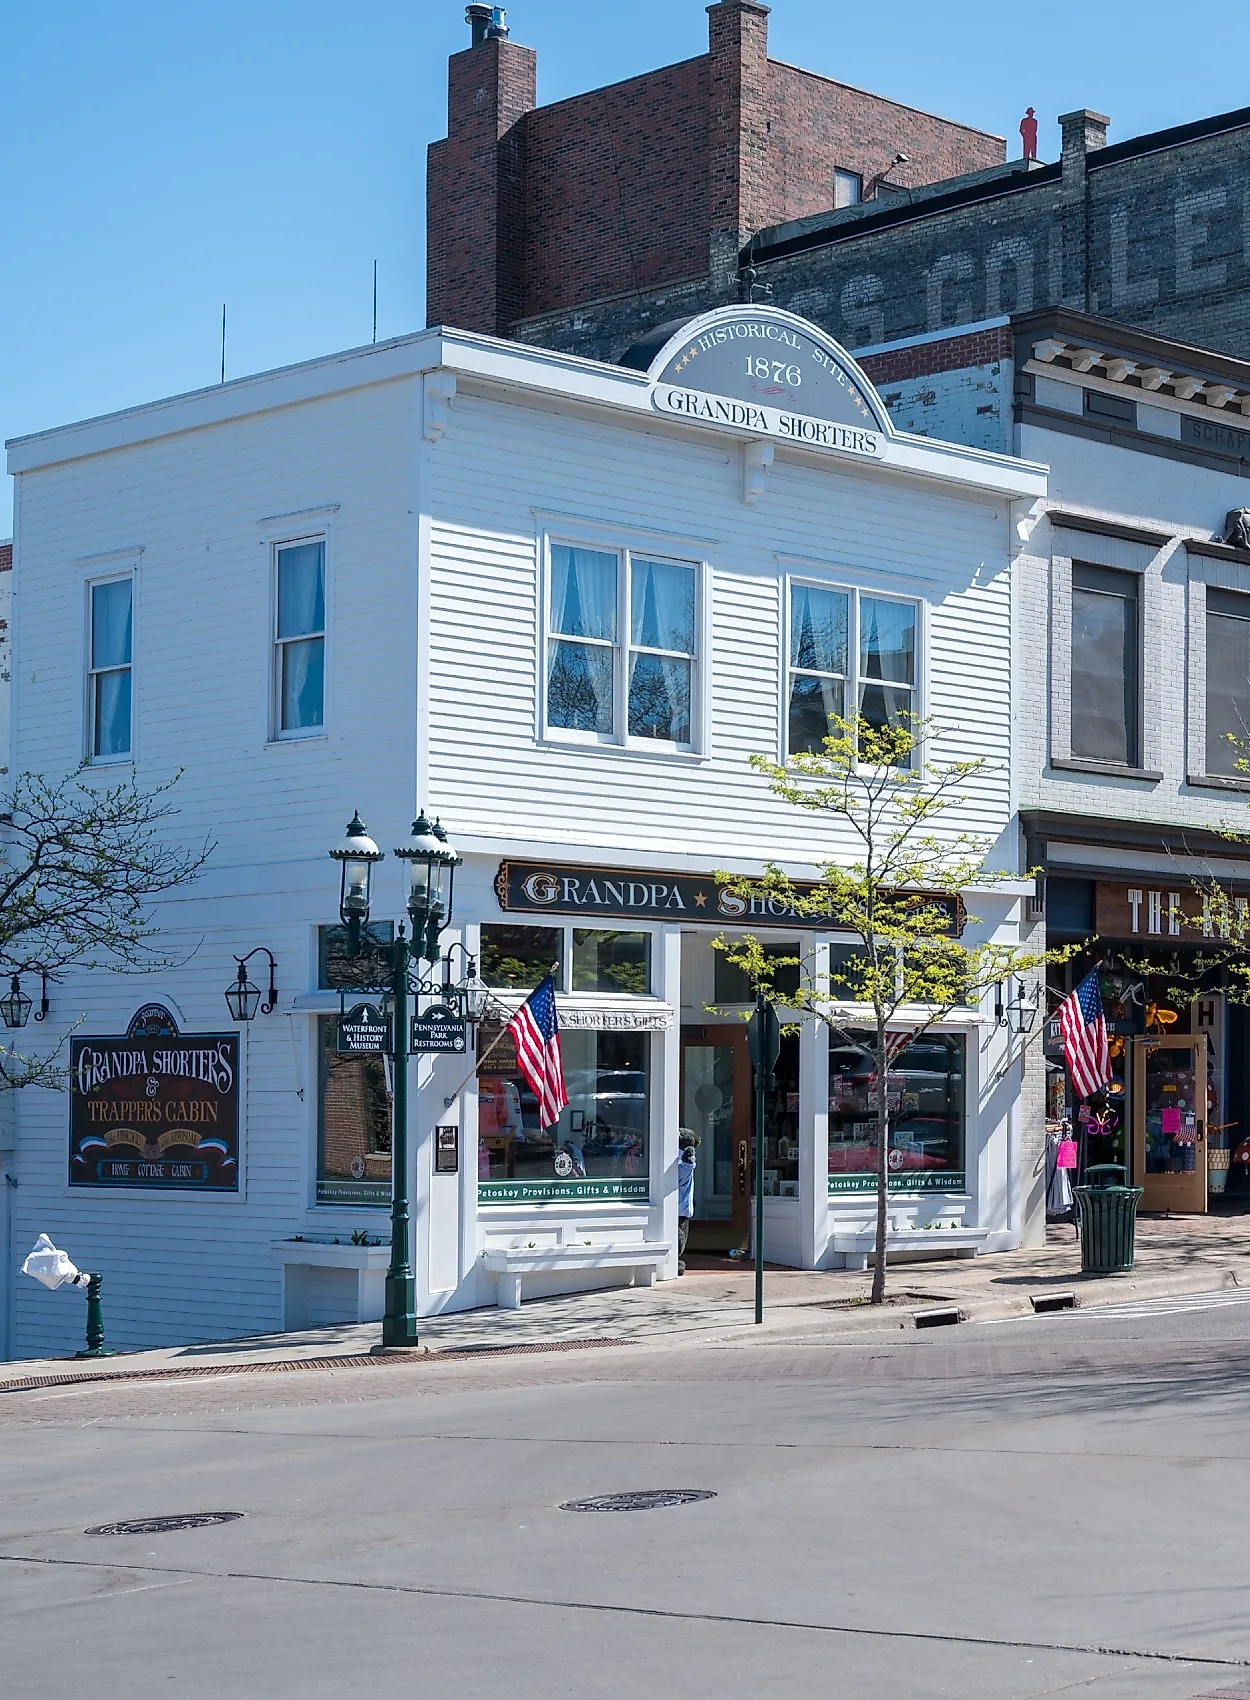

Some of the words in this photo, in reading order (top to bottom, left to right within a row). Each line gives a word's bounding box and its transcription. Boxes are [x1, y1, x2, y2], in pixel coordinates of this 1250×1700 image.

[698, 323, 801, 352] HISTORICAL
[811, 348, 849, 387] SITE
[745, 354, 802, 387] 1876
[667, 390, 769, 430] GRANDPA
[778, 415, 877, 454] SHORTER'S
[521, 872, 687, 910] GRANDPA
[1127, 889, 1181, 936] THE
[342, 1024, 387, 1033] WATERFRONT
[414, 1023, 464, 1032] PENNSYLVANIA
[634, 1016, 667, 1028] GIFTS
[346, 1034, 352, 1042] &
[353, 1033, 383, 1042] HISTORY
[414, 1039, 453, 1048] RESTROOMS
[349, 1042, 380, 1050] MUSEUM
[78, 1046, 149, 1096] GRANDPA
[151, 1040, 233, 1094] SHORTER'S
[145, 1076, 160, 1097] &
[88, 1098, 162, 1123] TRAPPER'S
[165, 1100, 220, 1123] CABIN
[111, 1163, 130, 1176] HOME
[137, 1163, 164, 1177] COTTAGE
[171, 1164, 192, 1177] CABIN
[862, 1179, 904, 1188] Provons,
[906, 1178, 925, 1187] Gifts
[927, 1178, 933, 1186] &
[935, 1177, 963, 1186] Wisdom
[477, 1187, 519, 1199] Petoskey
[522, 1186, 574, 1198] Provisions,
[576, 1184, 600, 1196] Gifts
[603, 1185, 608, 1194] &
[612, 1184, 646, 1194] Wisdom
